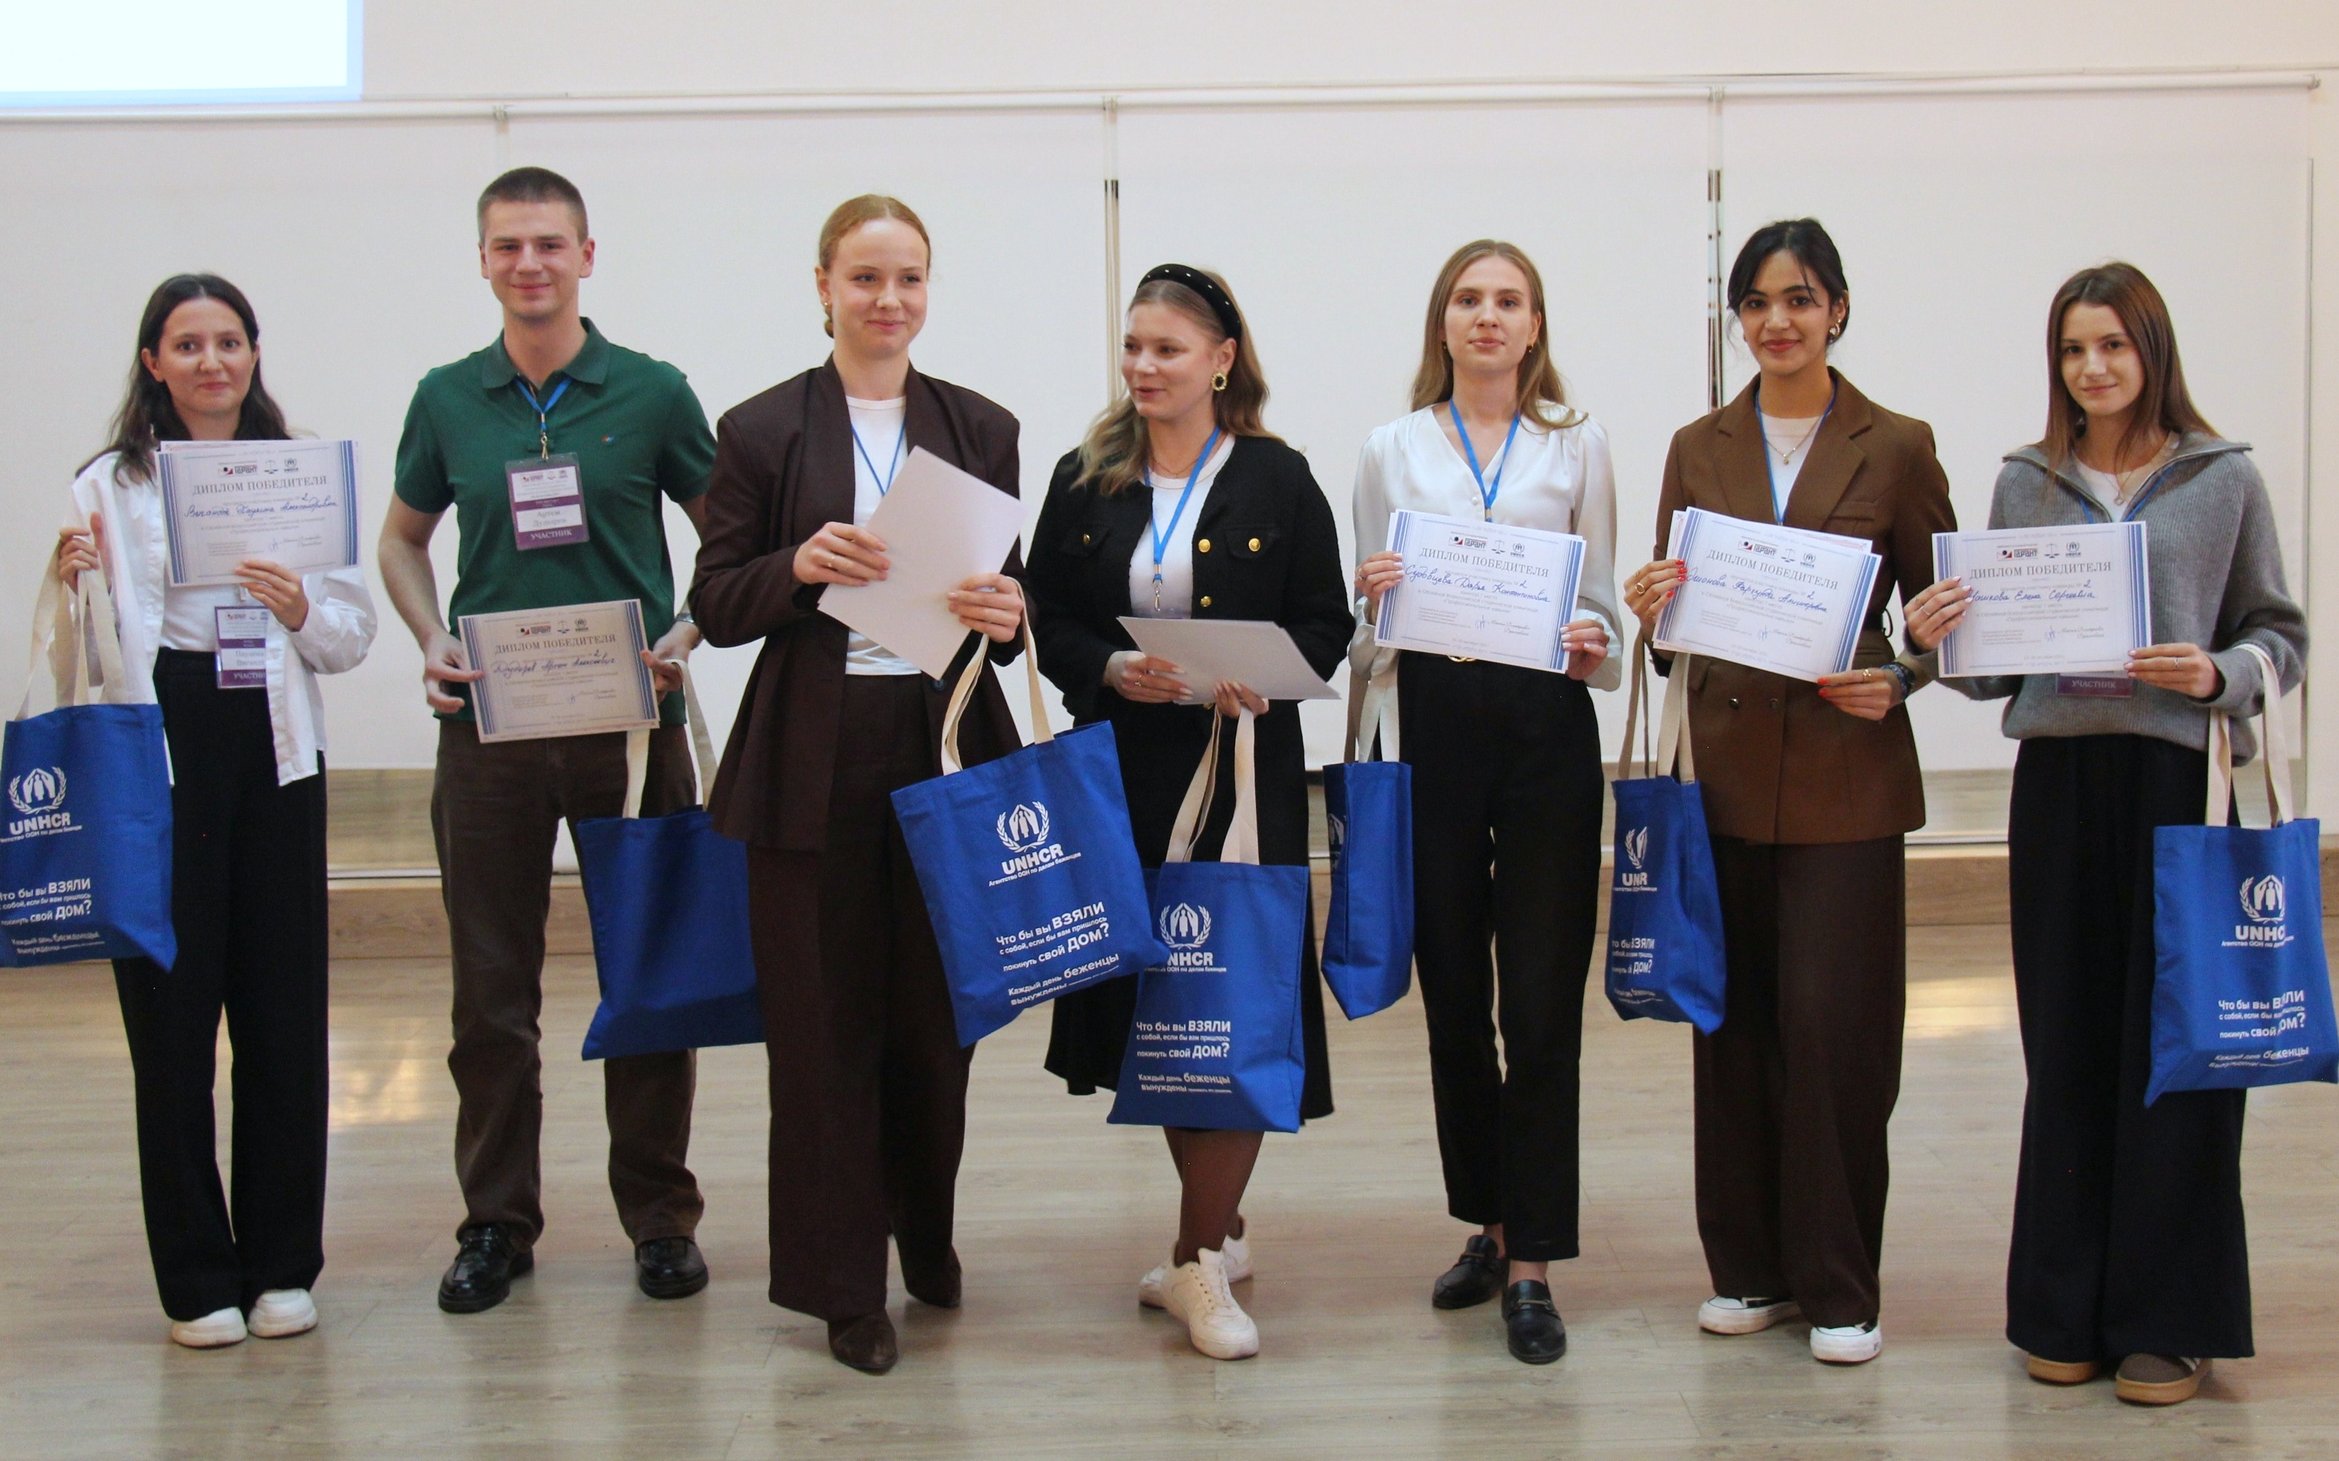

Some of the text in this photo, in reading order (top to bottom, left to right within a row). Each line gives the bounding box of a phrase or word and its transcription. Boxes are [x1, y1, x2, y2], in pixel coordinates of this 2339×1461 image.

[192, 476, 327, 496] ДИПЛОМ ПОБЕДИТЕЛЯ
[530, 529, 572, 540] УЧАСТНИК
[1419, 547, 1549, 578] ДИПЛОМ ПОБЕДИТЕЛЯ
[1706, 549, 1757, 569] ДИПЛОМ
[1760, 563, 1839, 590] ПОБЕДИТЕЛЯ
[1969, 561, 2111, 580] ДИПЛОМ ПОБЕДИТЕЛЯ
[495, 634, 616, 656] ДИПЛОМ ПОБЕДИТЕЛЯ
[10, 812, 71, 835] UNHCR
[1001, 844, 1064, 875] UNHCR
[18, 888, 33, 898] бы
[48, 878, 91, 894] ВЗЯЛИ
[30, 911, 53, 923] свой
[55, 900, 92, 920] ДОМ?
[996, 901, 1105, 945] Что бы вы ВЗЯЛИ
[1028, 938, 1045, 948] если
[1046, 934, 1056, 942] бы
[1057, 929, 1071, 938] вам
[1072, 917, 1108, 933] пришлось
[1003, 922, 1110, 972] покинуть свой ДОМ?
[1167, 952, 1213, 966] NHCR
[1008, 981, 1041, 996] Каждый
[1063, 954, 1120, 978] беженцы
[2218, 1000, 2235, 1010] Что
[2236, 1000, 2250, 1010] бы
[2252, 1002, 2270, 1010] вы
[1136, 1021, 1153, 1031] Что
[1155, 1022, 1170, 1031] бы
[1188, 1020, 1231, 1032] ВЗЯЛИ
[2250, 1027, 2277, 1037] свой
[2277, 1012, 2306, 1037] ОМ?
[1169, 1047, 1190, 1058] свой
[1192, 1042, 1230, 1059] ДОМ?
[1184, 1072, 1231, 1085] беженцы
